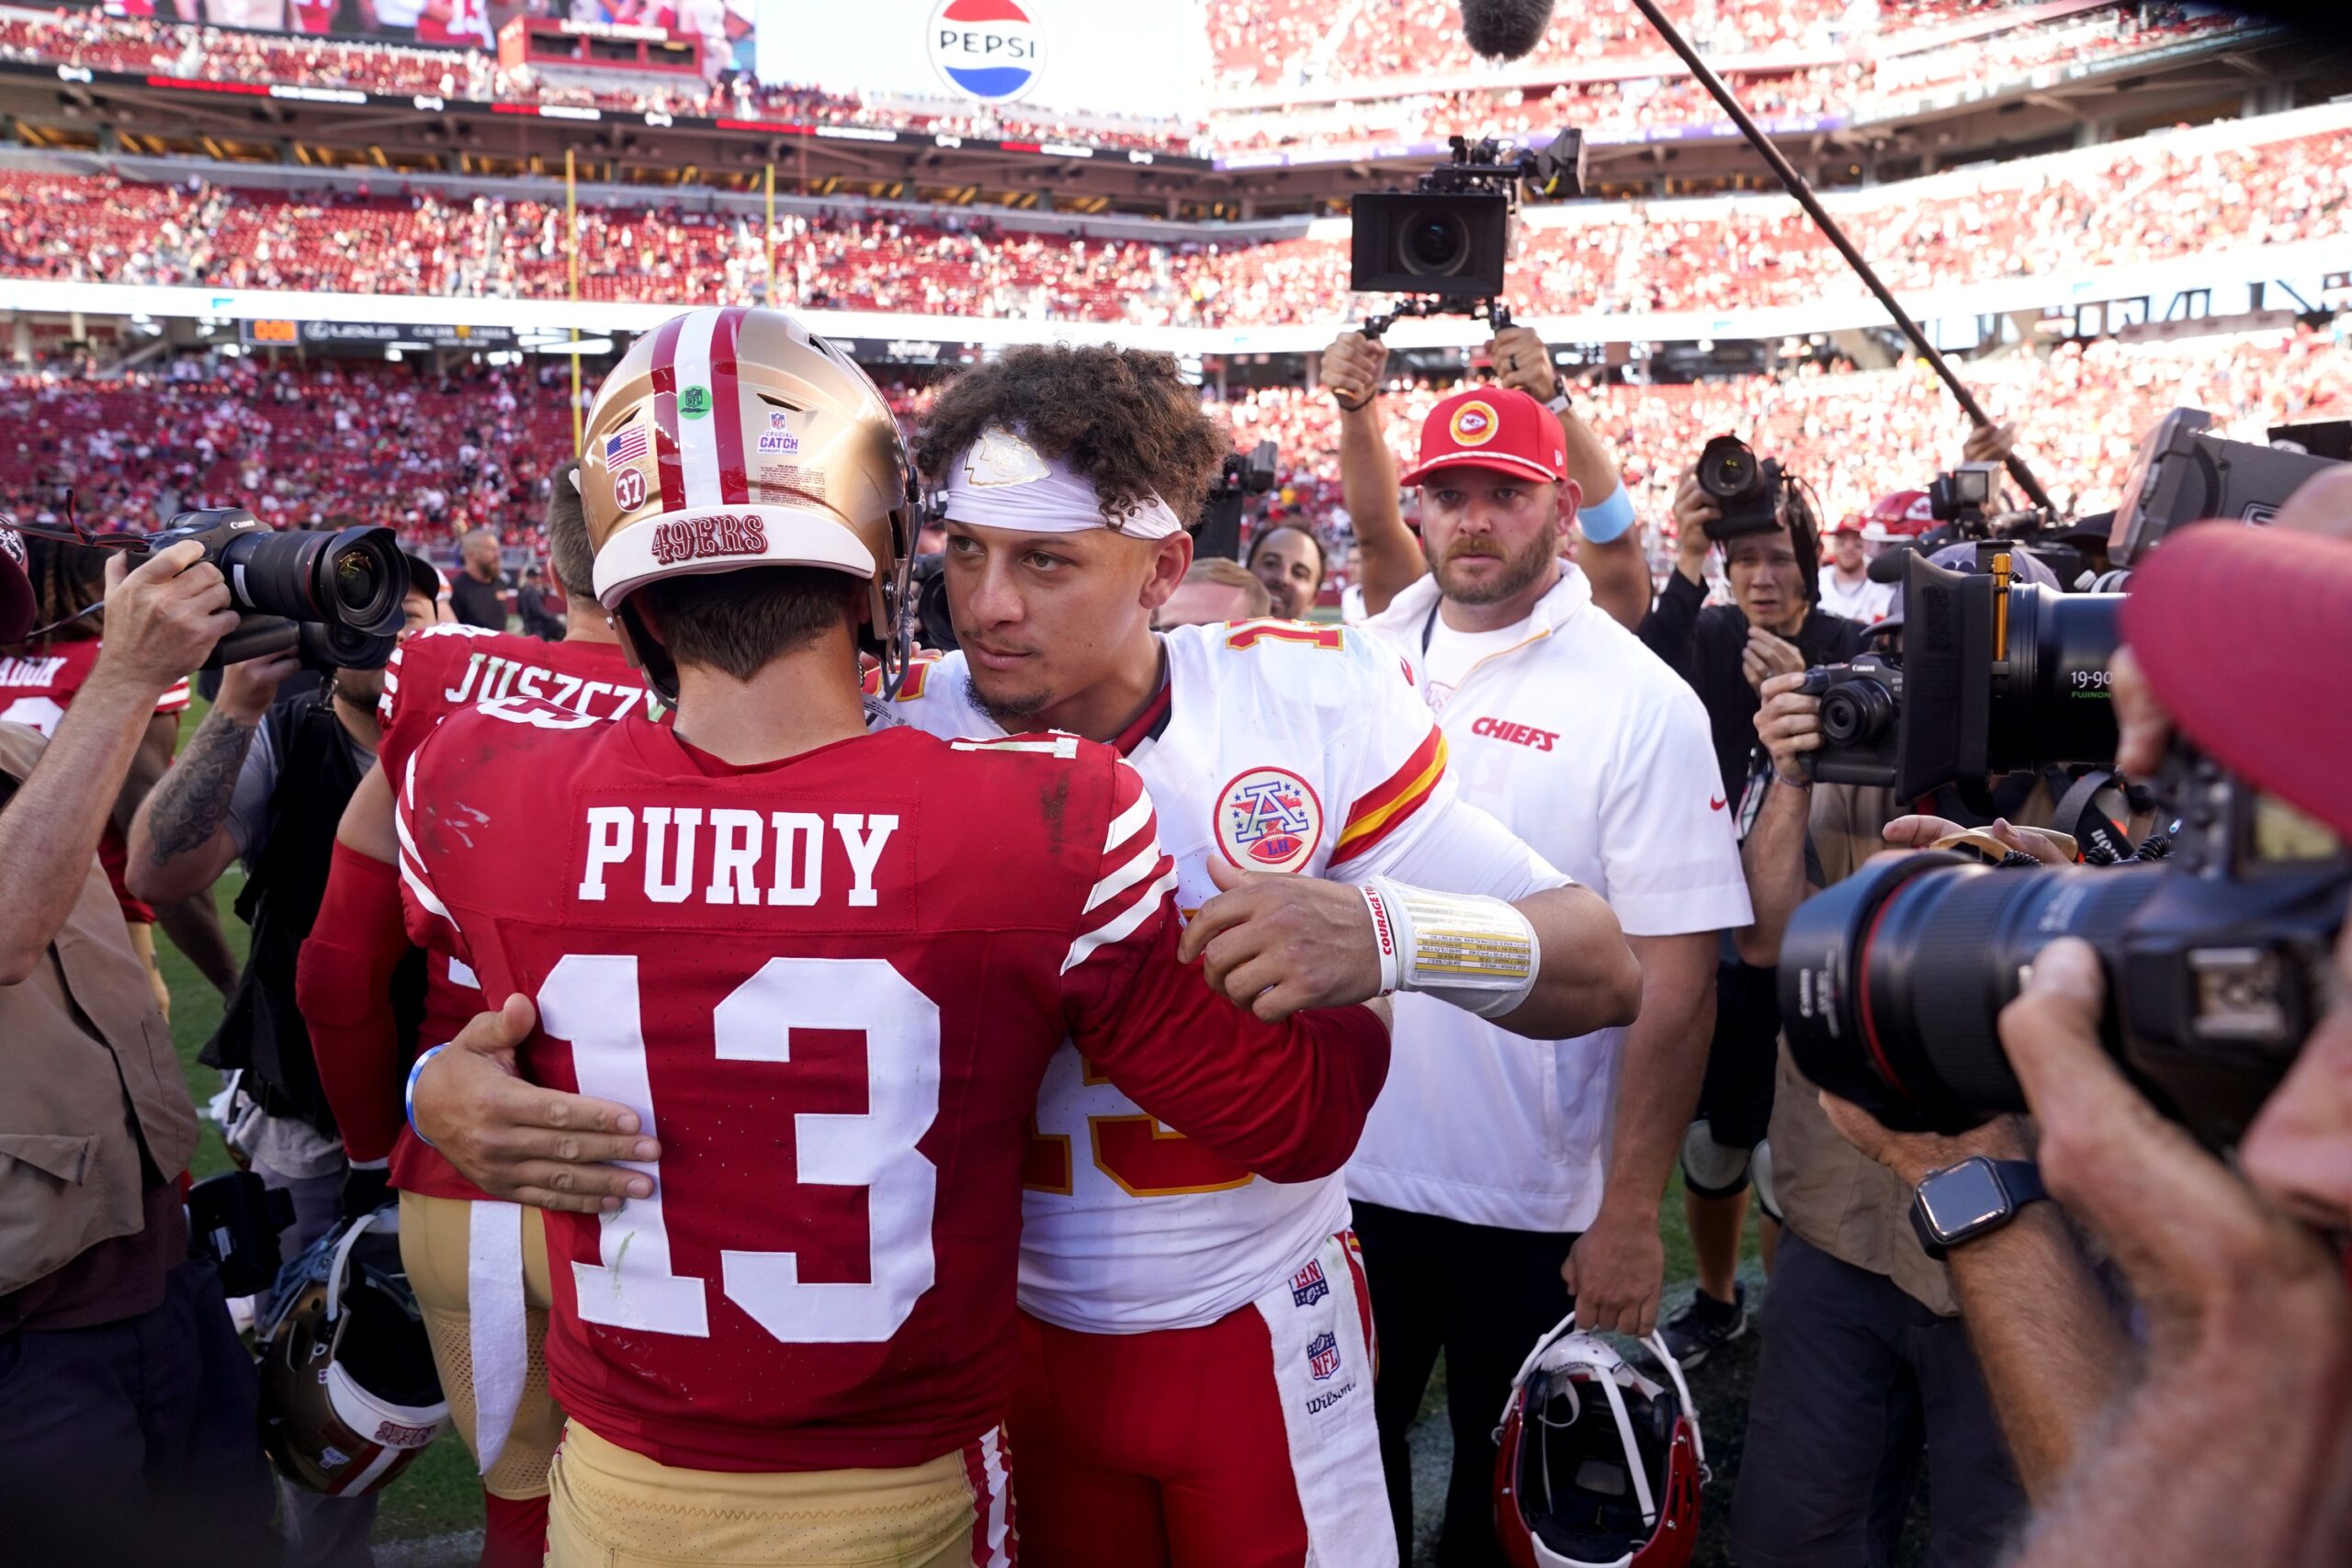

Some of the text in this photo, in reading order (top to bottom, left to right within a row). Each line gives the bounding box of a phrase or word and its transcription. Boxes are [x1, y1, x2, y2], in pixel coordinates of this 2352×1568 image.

[940, 28, 1035, 59] PEPSI
[760, 436, 798, 450] CATCH
[616, 472, 642, 508] 37
[230, 520, 255, 529] Canon
[651, 514, 768, 566] 49ERS
[1852, 664, 1876, 672] Canon
[2071, 671, 2113, 689] 19-90
[1472, 717, 1560, 752] CHIEFS
[578, 807, 899, 907] PURDY
[1266, 840, 1290, 855] LH
[1368, 897, 1392, 956] COURAGE
[537, 953, 941, 1344] 13
[1310, 1349, 1339, 1378] NFL
[1306, 1382, 1352, 1415] Wilson
